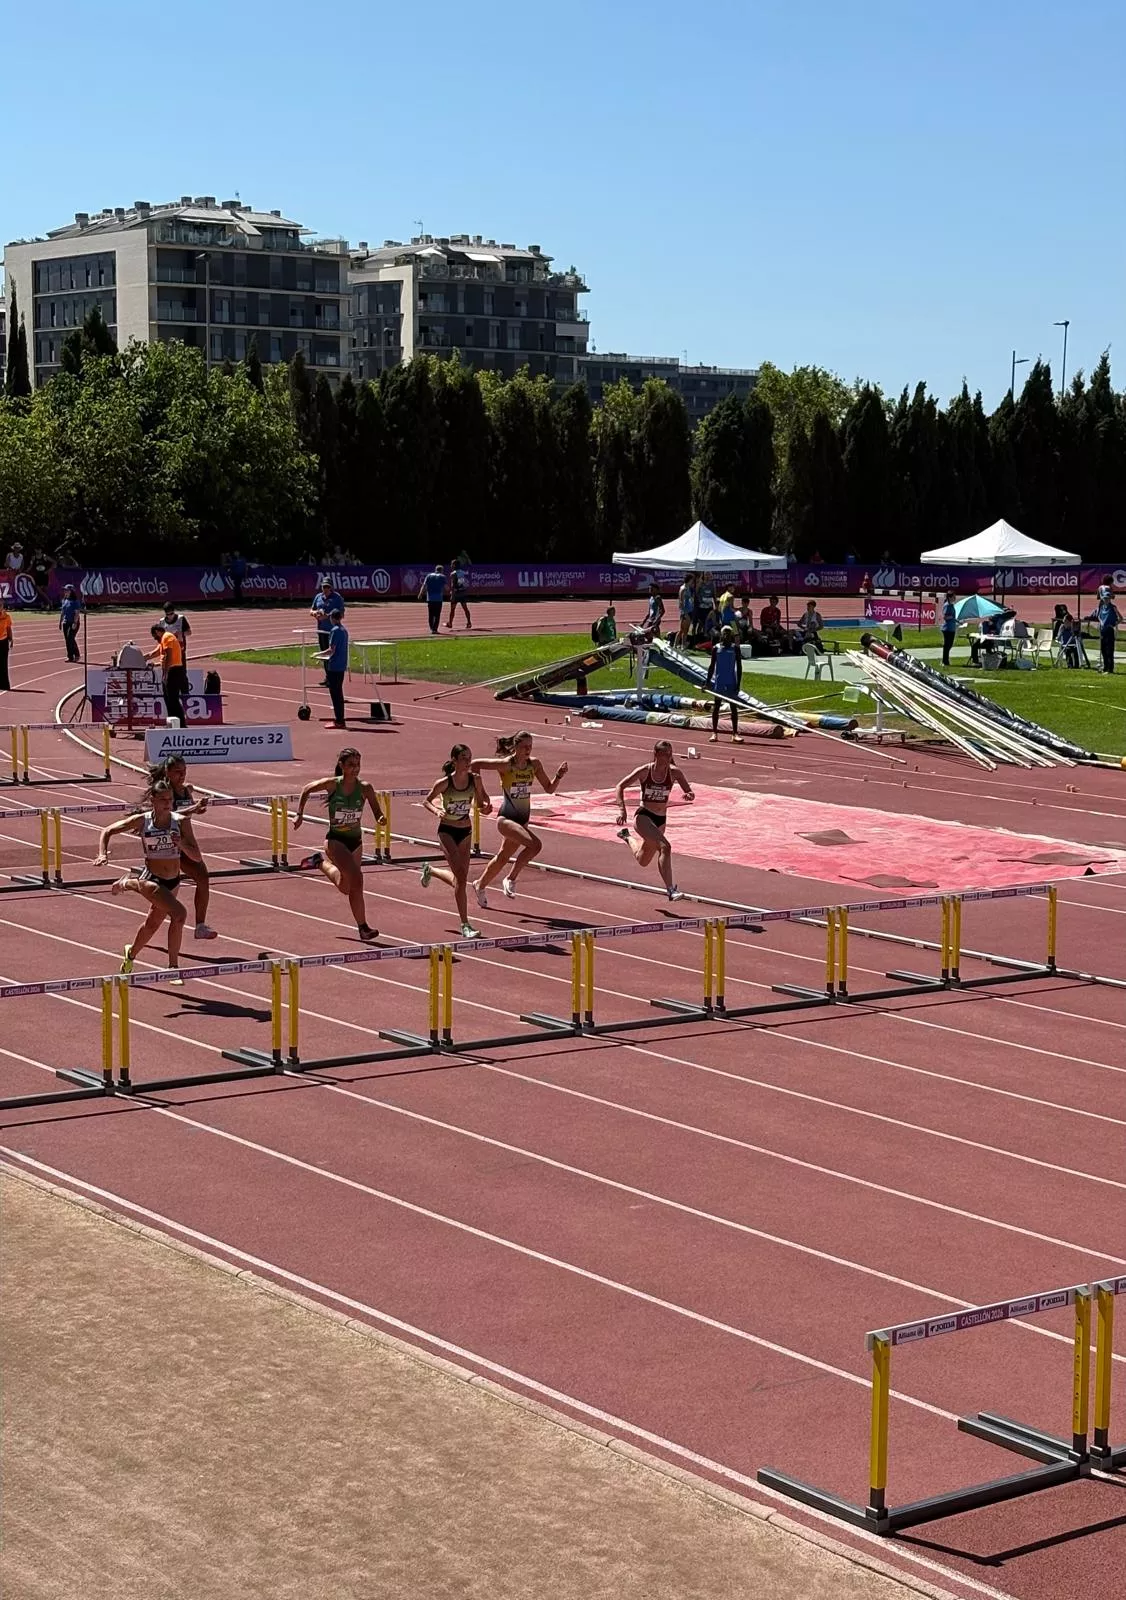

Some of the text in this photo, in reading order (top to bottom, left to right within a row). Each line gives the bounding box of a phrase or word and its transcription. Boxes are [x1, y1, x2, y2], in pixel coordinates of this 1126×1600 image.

[106, 576, 169, 595] Iberdrola
[1017, 571, 1078, 587] Iberdrola
[161, 733, 284, 748] Allianz Futures 32
[961, 1311, 991, 1327] CASTELLÓN
